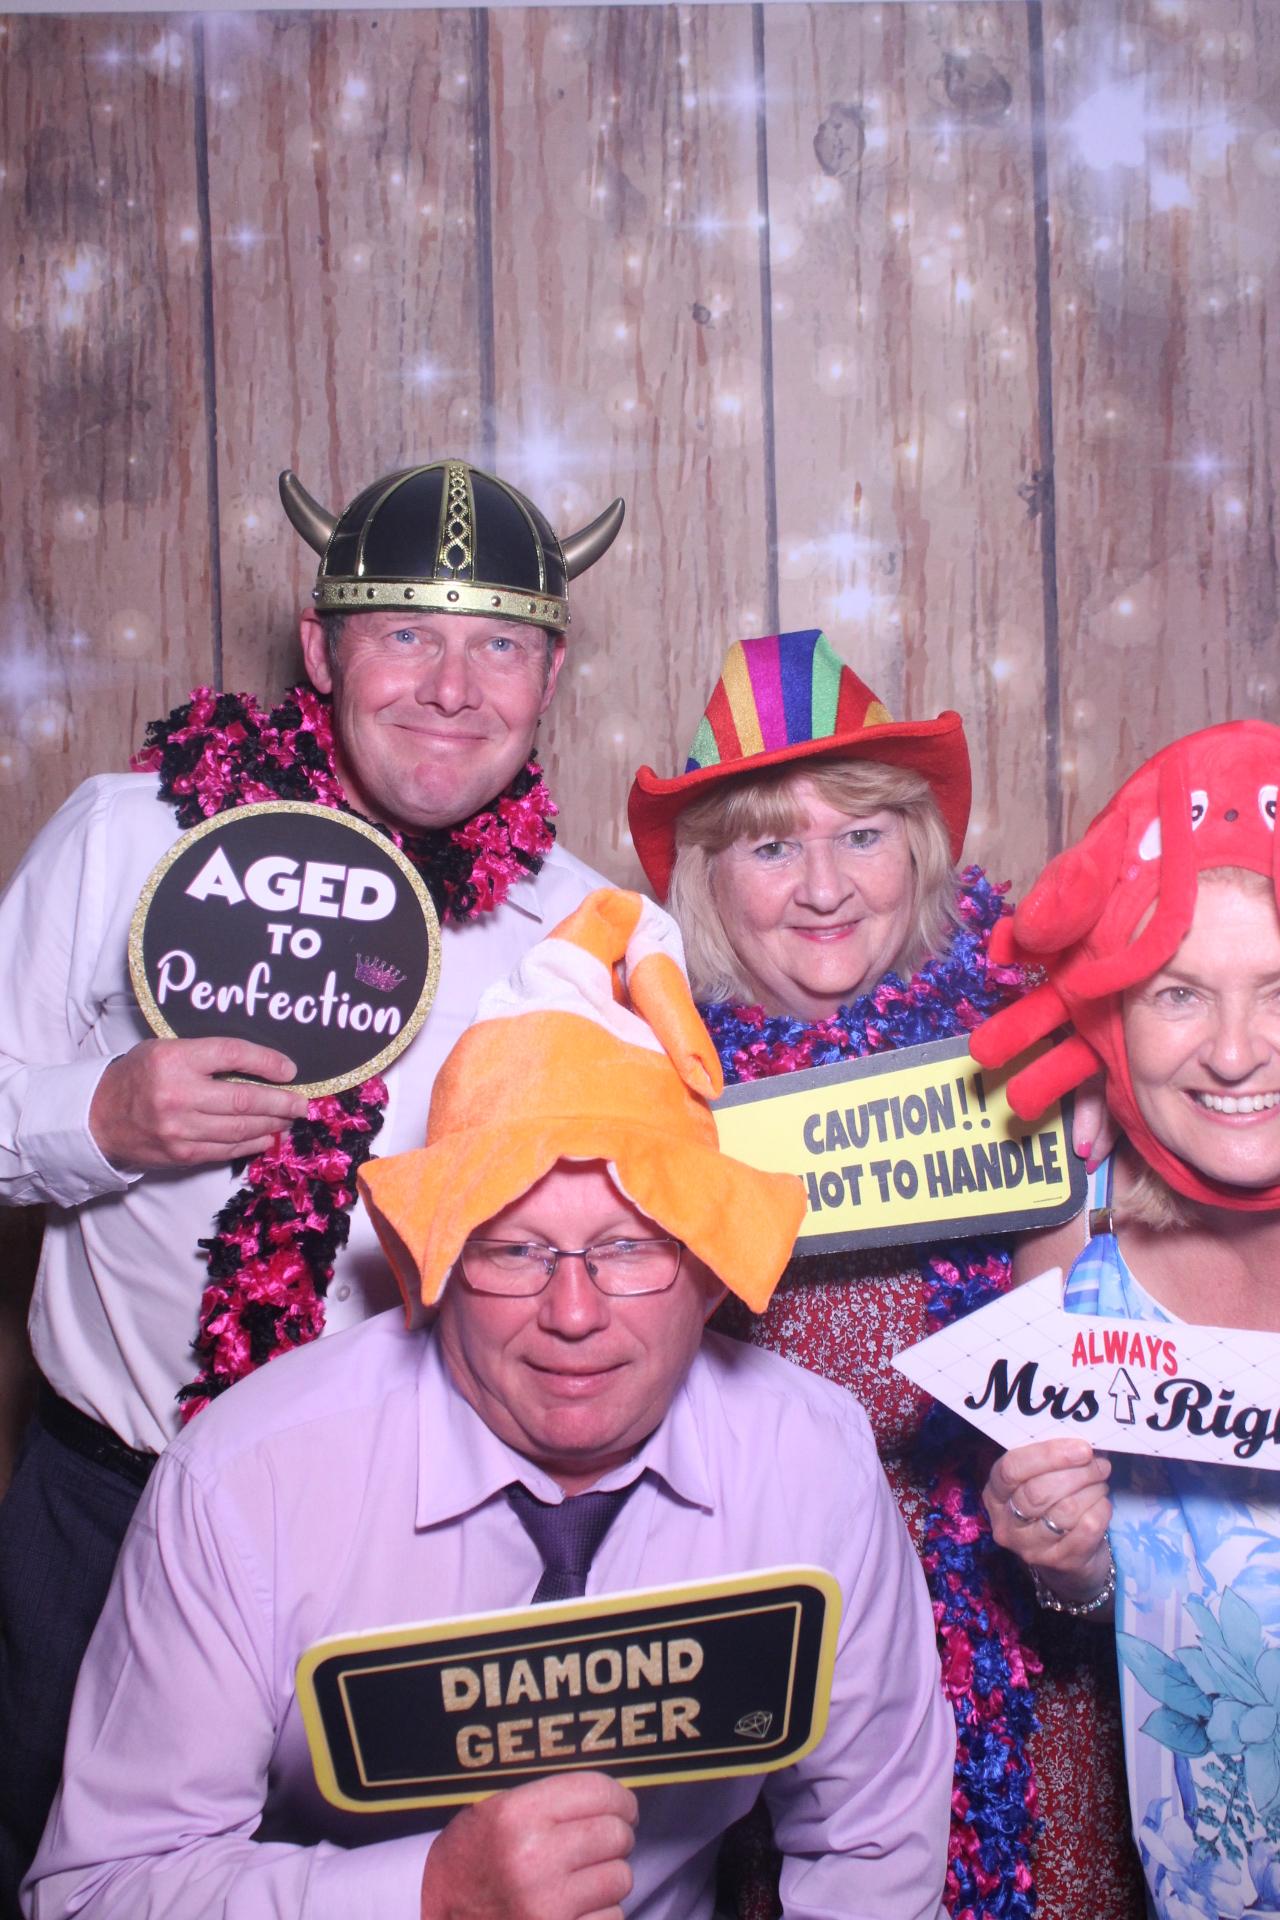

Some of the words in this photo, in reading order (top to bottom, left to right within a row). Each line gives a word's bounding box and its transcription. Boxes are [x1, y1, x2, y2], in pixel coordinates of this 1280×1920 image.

[185, 845, 397, 922] AGED
[267, 923, 322, 959] TO
[156, 949, 401, 1036] Perfection
[803, 1072, 991, 1155] CAUTION!!
[869, 1158, 919, 1202] TO
[924, 1131, 1063, 1199] HANDLE
[1071, 1330, 1179, 1377] ALWAYS
[964, 1359, 1100, 1422] Mrs
[1146, 1378, 1280, 1459] Rig
[441, 1637, 705, 1713] DIAMOND
[455, 1696, 702, 1769] GEEZER
